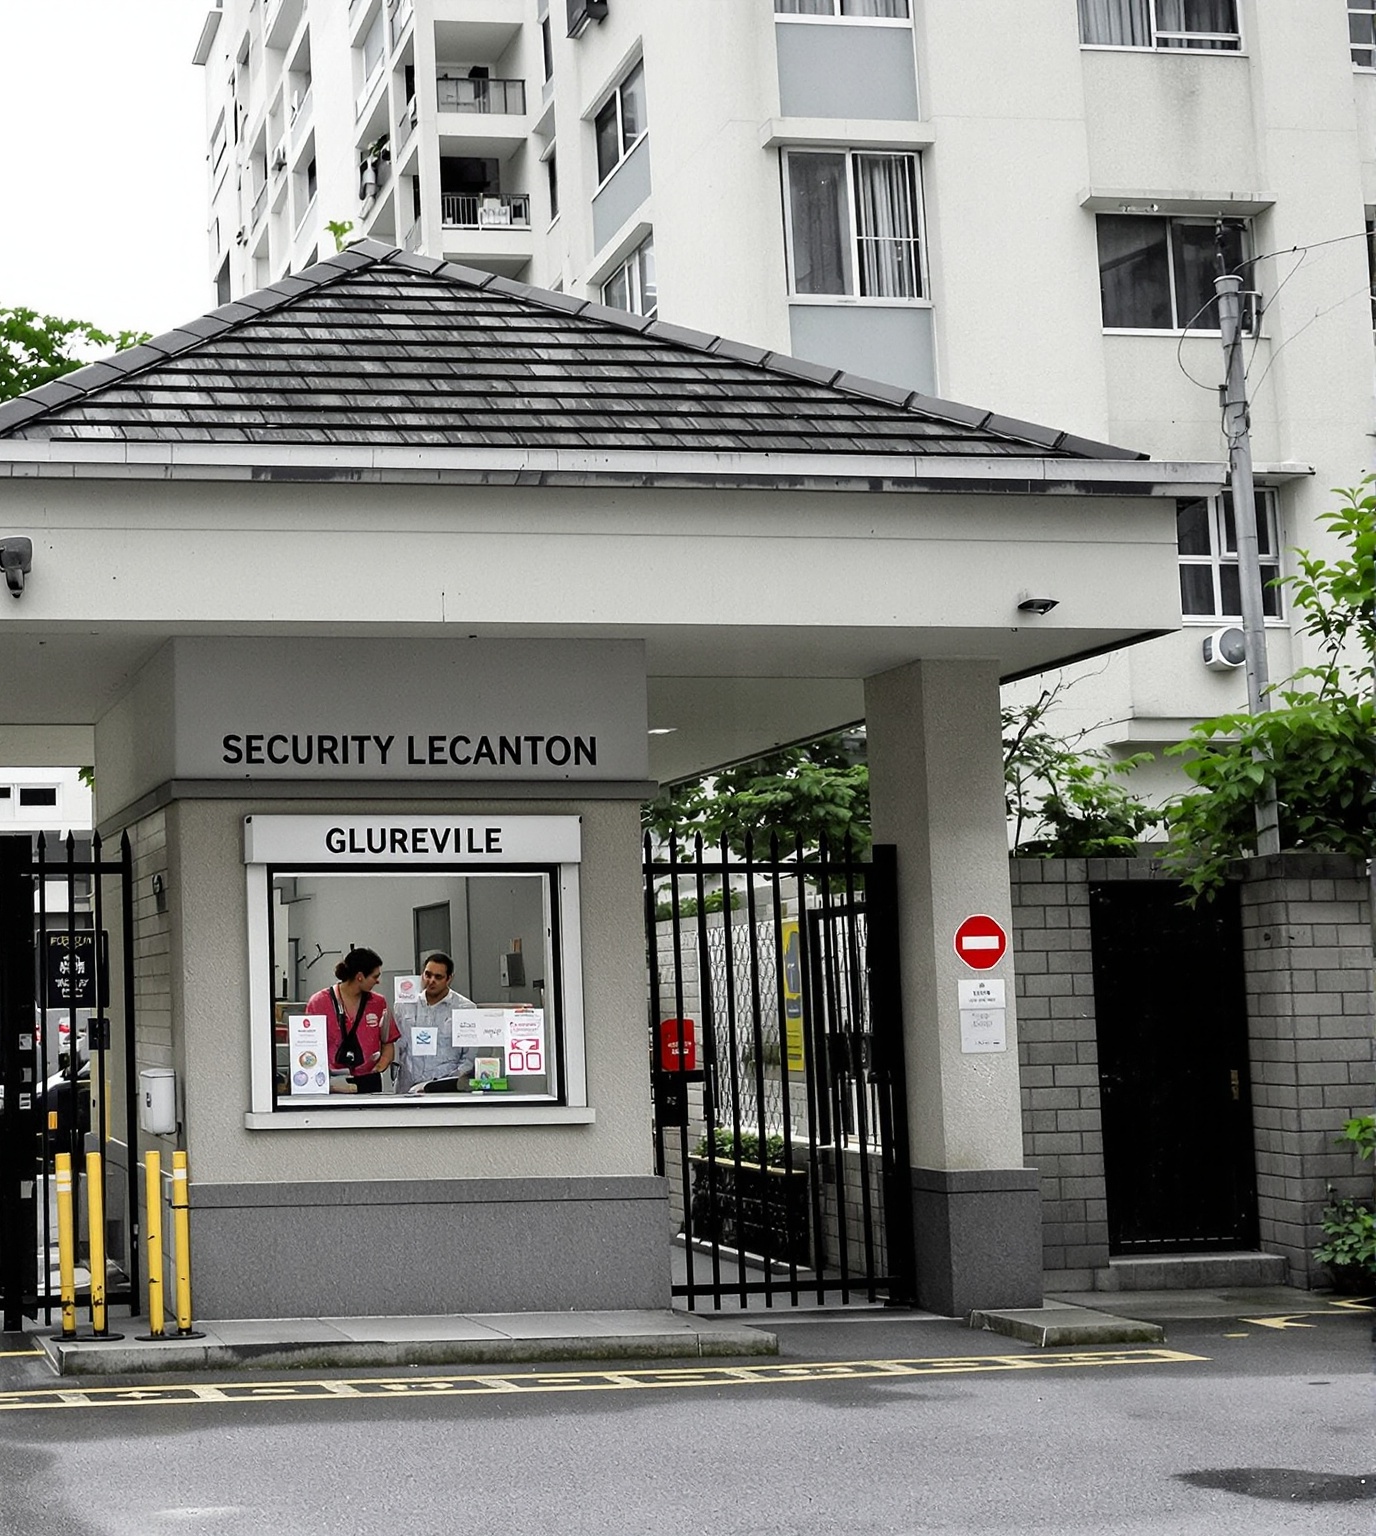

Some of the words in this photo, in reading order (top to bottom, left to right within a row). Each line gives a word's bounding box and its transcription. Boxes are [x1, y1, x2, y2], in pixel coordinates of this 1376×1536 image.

[222, 734, 395, 765] SECURITY
[407, 735, 598, 766] LECANTON
[325, 827, 503, 854] GLUREVILE
